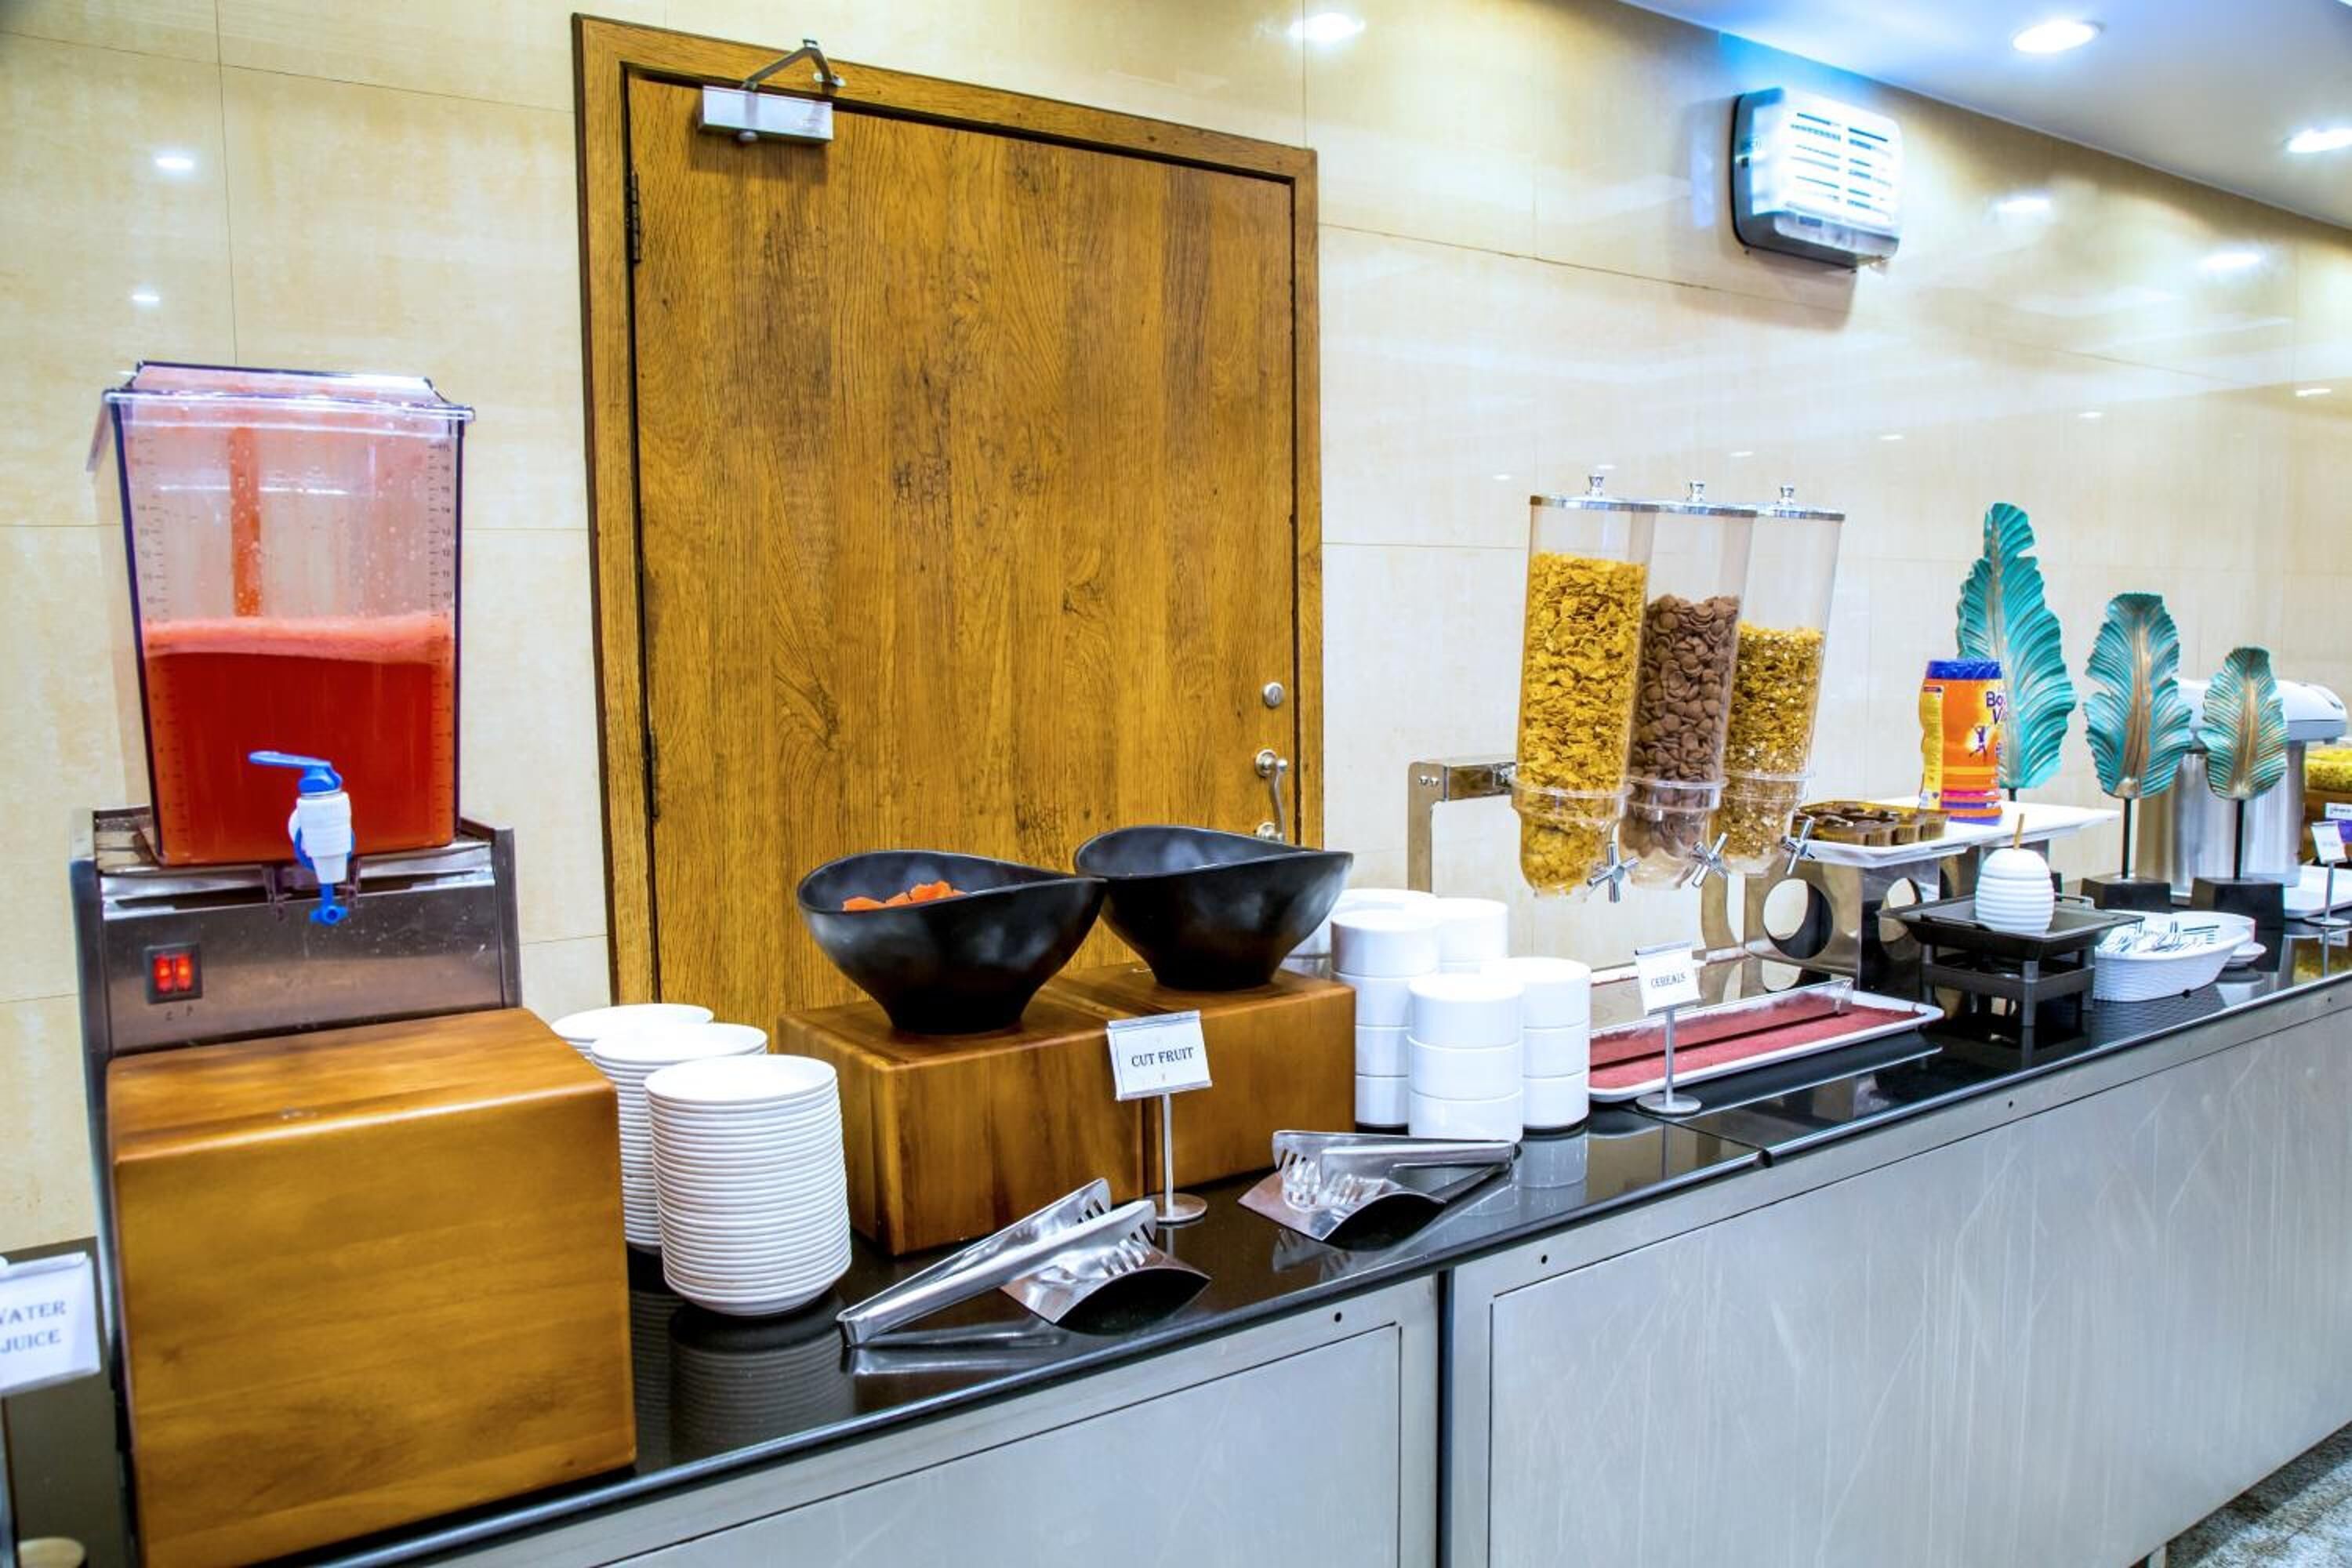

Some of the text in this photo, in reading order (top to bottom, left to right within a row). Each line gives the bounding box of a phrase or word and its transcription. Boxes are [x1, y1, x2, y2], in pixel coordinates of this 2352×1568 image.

[1131, 1047, 1194, 1067] CUT FRUIT
[0, 1329, 62, 1354] JUICE
